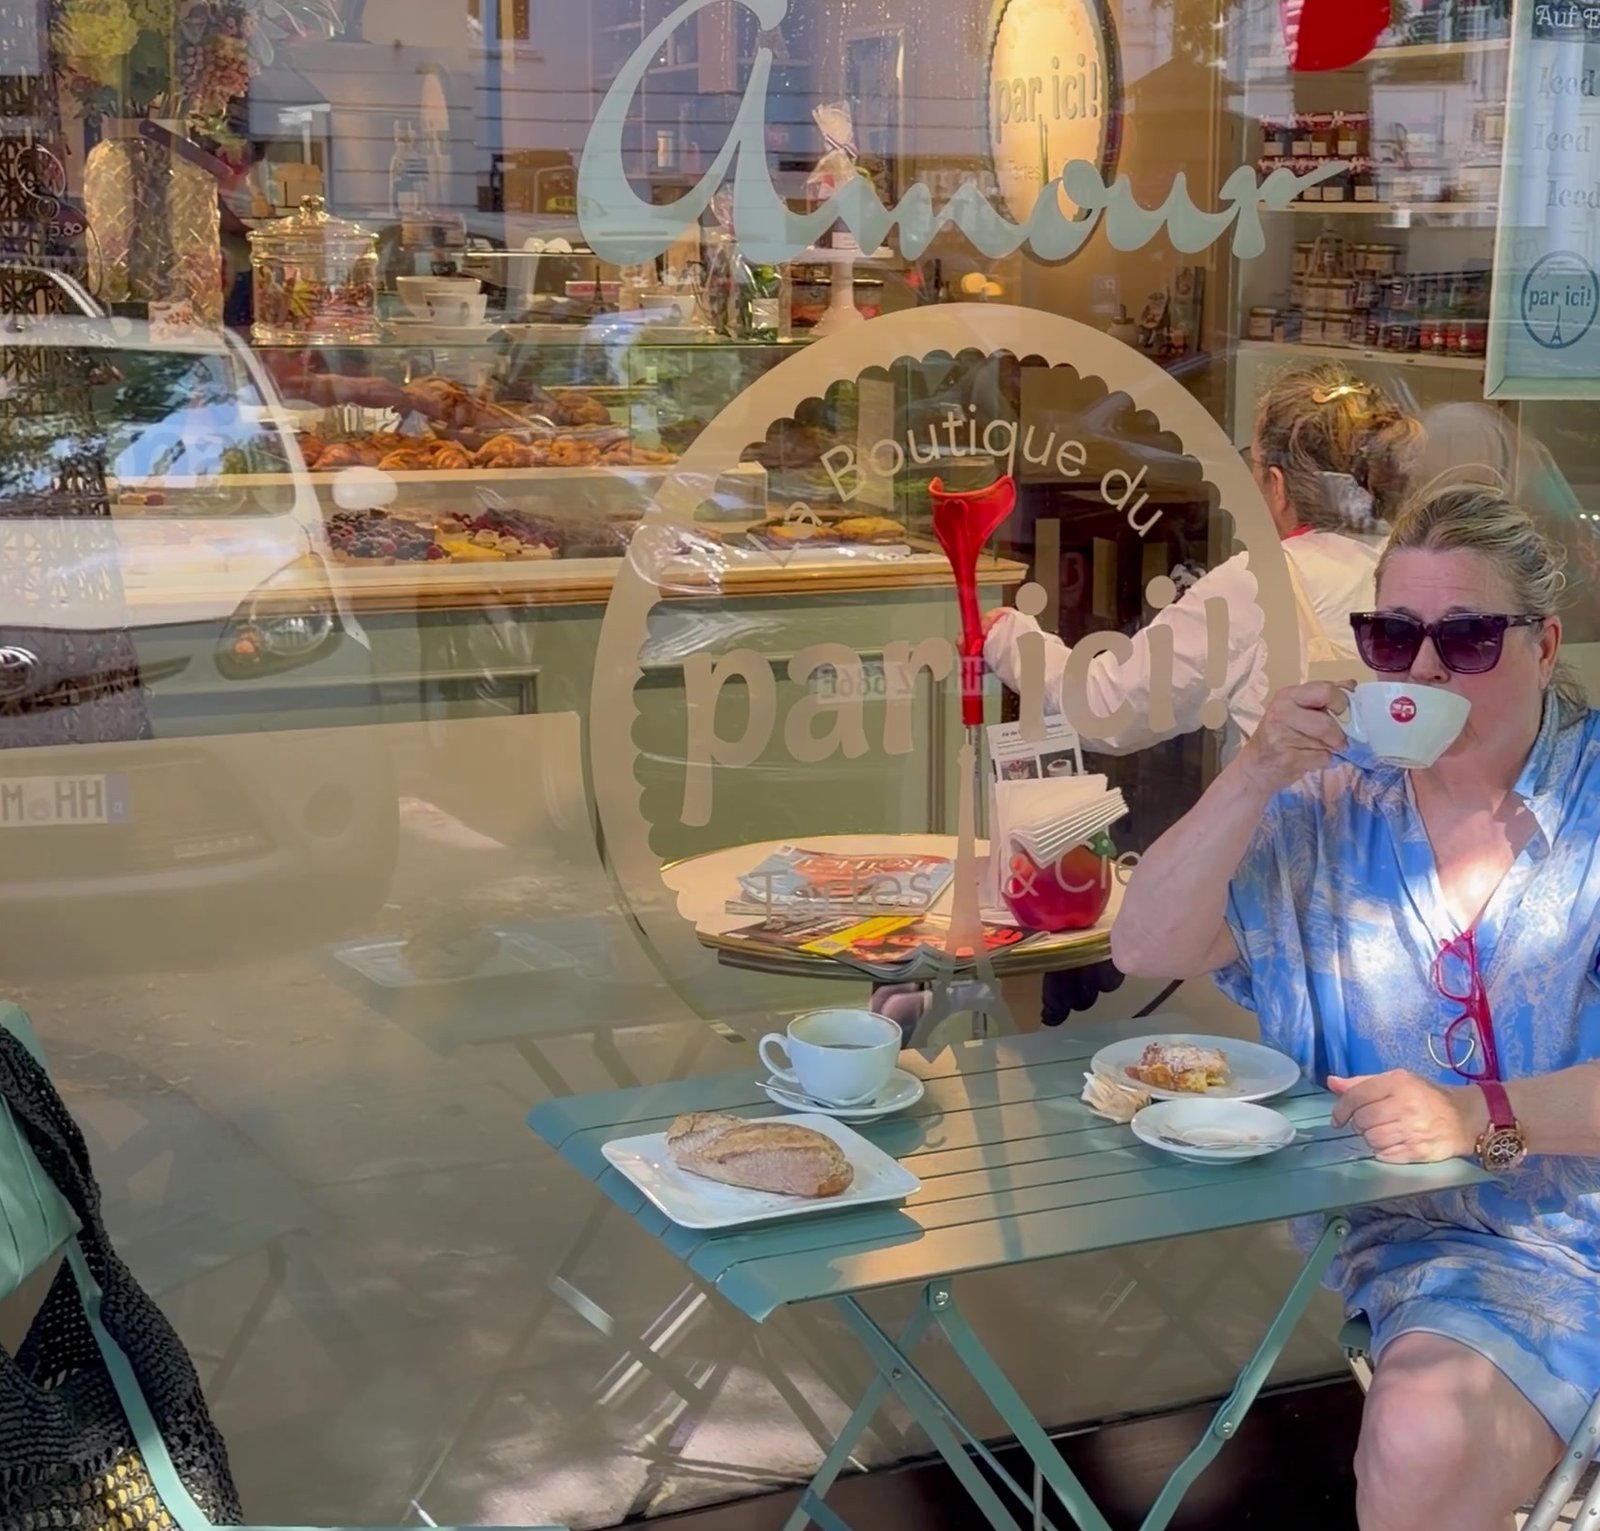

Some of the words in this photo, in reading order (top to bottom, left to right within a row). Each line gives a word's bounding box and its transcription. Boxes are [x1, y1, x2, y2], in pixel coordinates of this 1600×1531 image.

[1535, 5, 1578, 27] Auf
[1537, 66, 1595, 97] Iced
[995, 76, 1042, 144] par
[1052, 53, 1099, 120] ici!
[1531, 123, 1590, 152] Iced
[1545, 179, 1600, 209] Iced
[1528, 289, 1560, 312] par
[1565, 284, 1592, 307] ici!
[820, 404, 1088, 502] Boutique
[1100, 463, 1164, 538] du
[678, 636, 952, 828] par
[1015, 574, 1231, 741] ici!
[748, 868, 933, 927] Tartes
[1003, 852, 1039, 899] &
